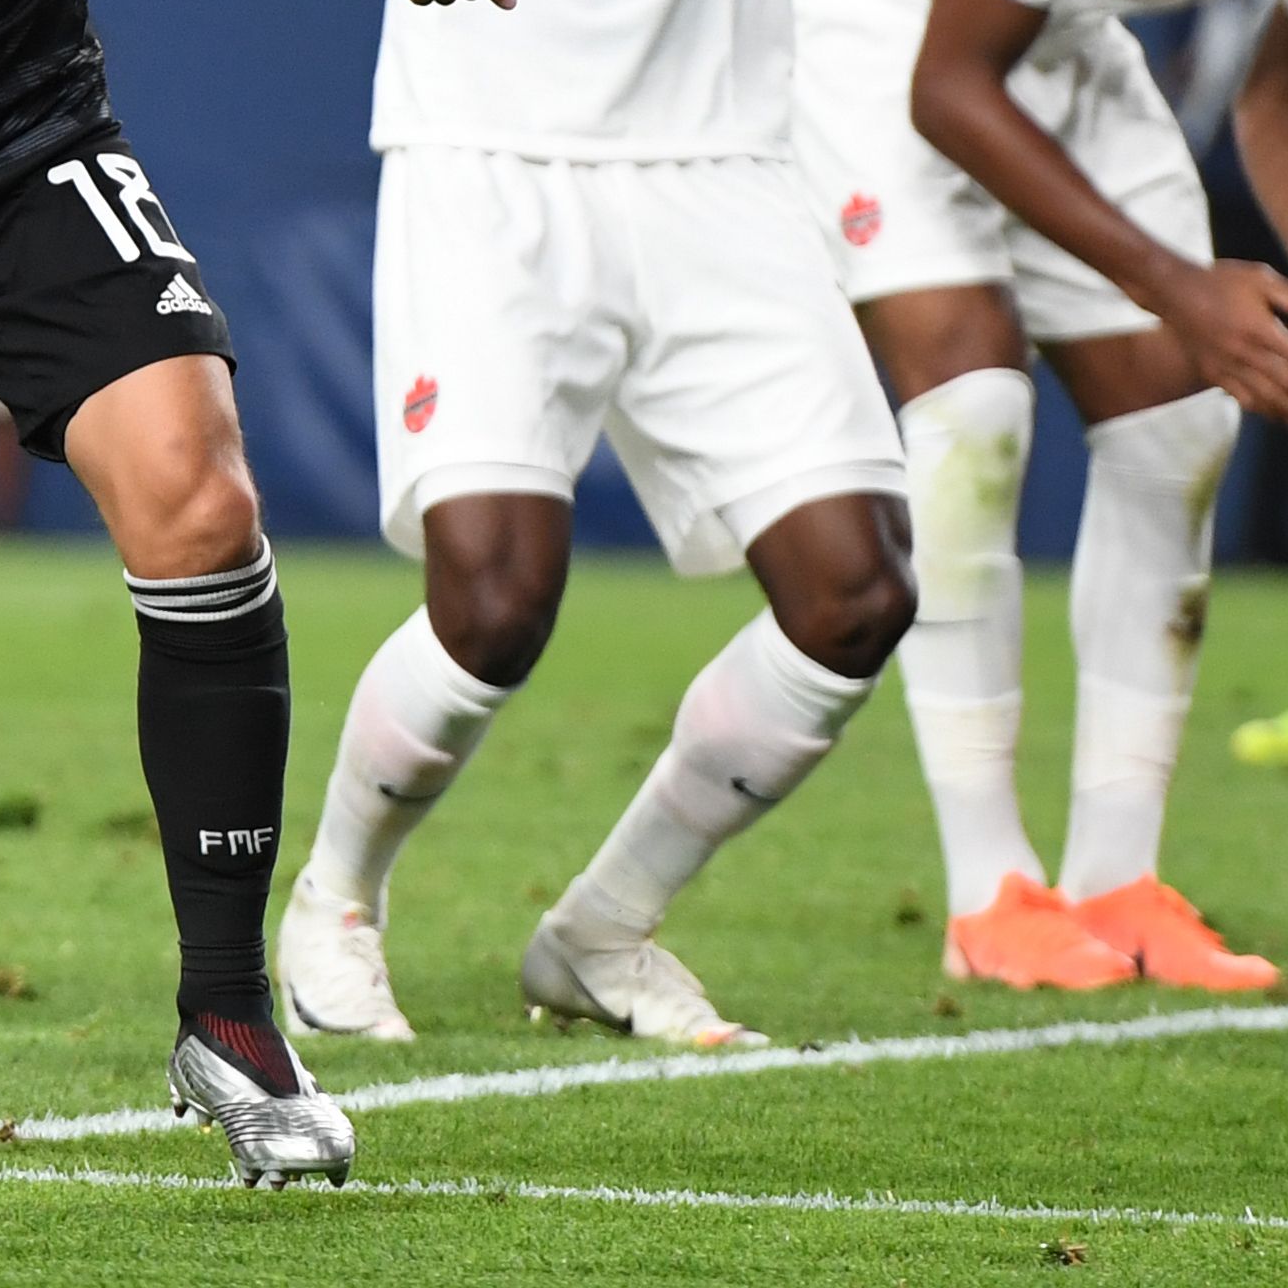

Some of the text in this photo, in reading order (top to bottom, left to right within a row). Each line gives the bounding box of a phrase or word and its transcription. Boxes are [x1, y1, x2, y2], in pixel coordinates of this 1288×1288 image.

[47, 153, 197, 263] 18
[156, 297, 213, 315] adidas
[199, 826, 274, 856] FMF
